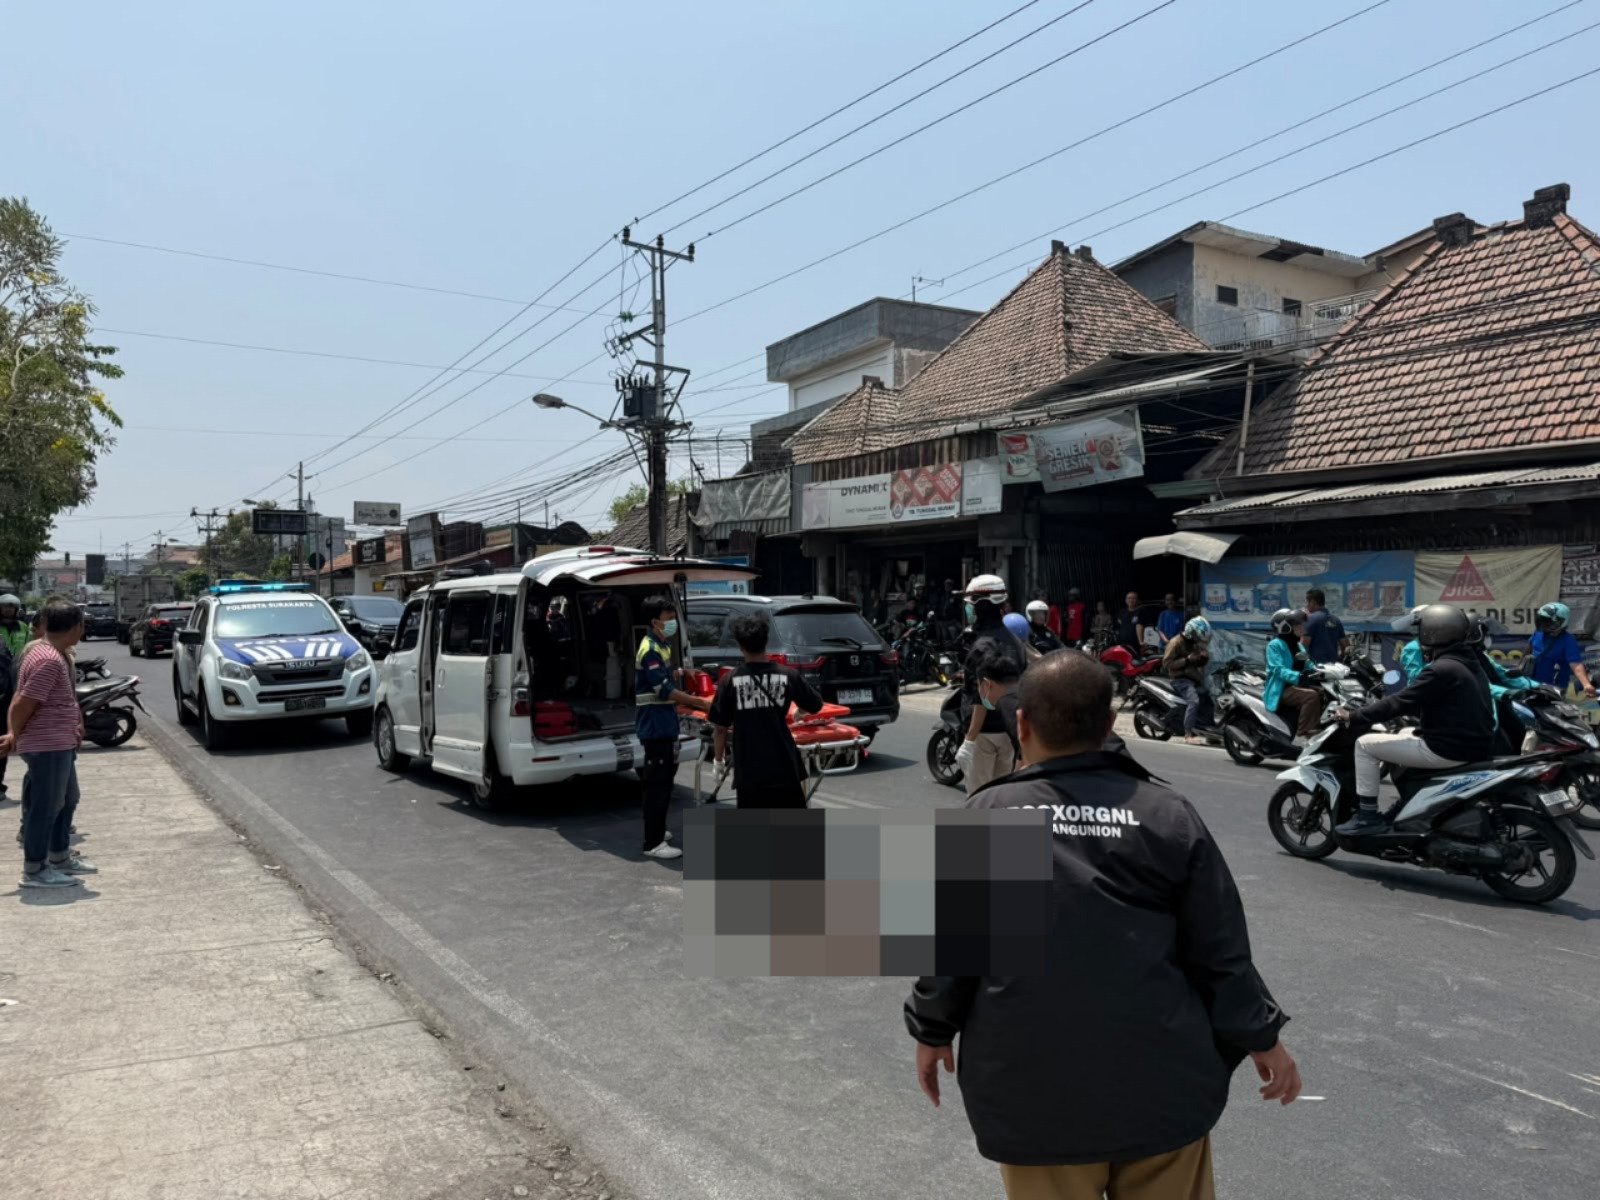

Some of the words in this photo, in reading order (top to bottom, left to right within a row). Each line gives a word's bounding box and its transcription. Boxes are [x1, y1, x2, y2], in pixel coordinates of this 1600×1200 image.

[1049, 456, 1091, 474] GRESIK
[226, 603, 267, 611] POLRESTA
[234, 638, 337, 647] POLISI
[286, 660, 314, 668] ISUZU
